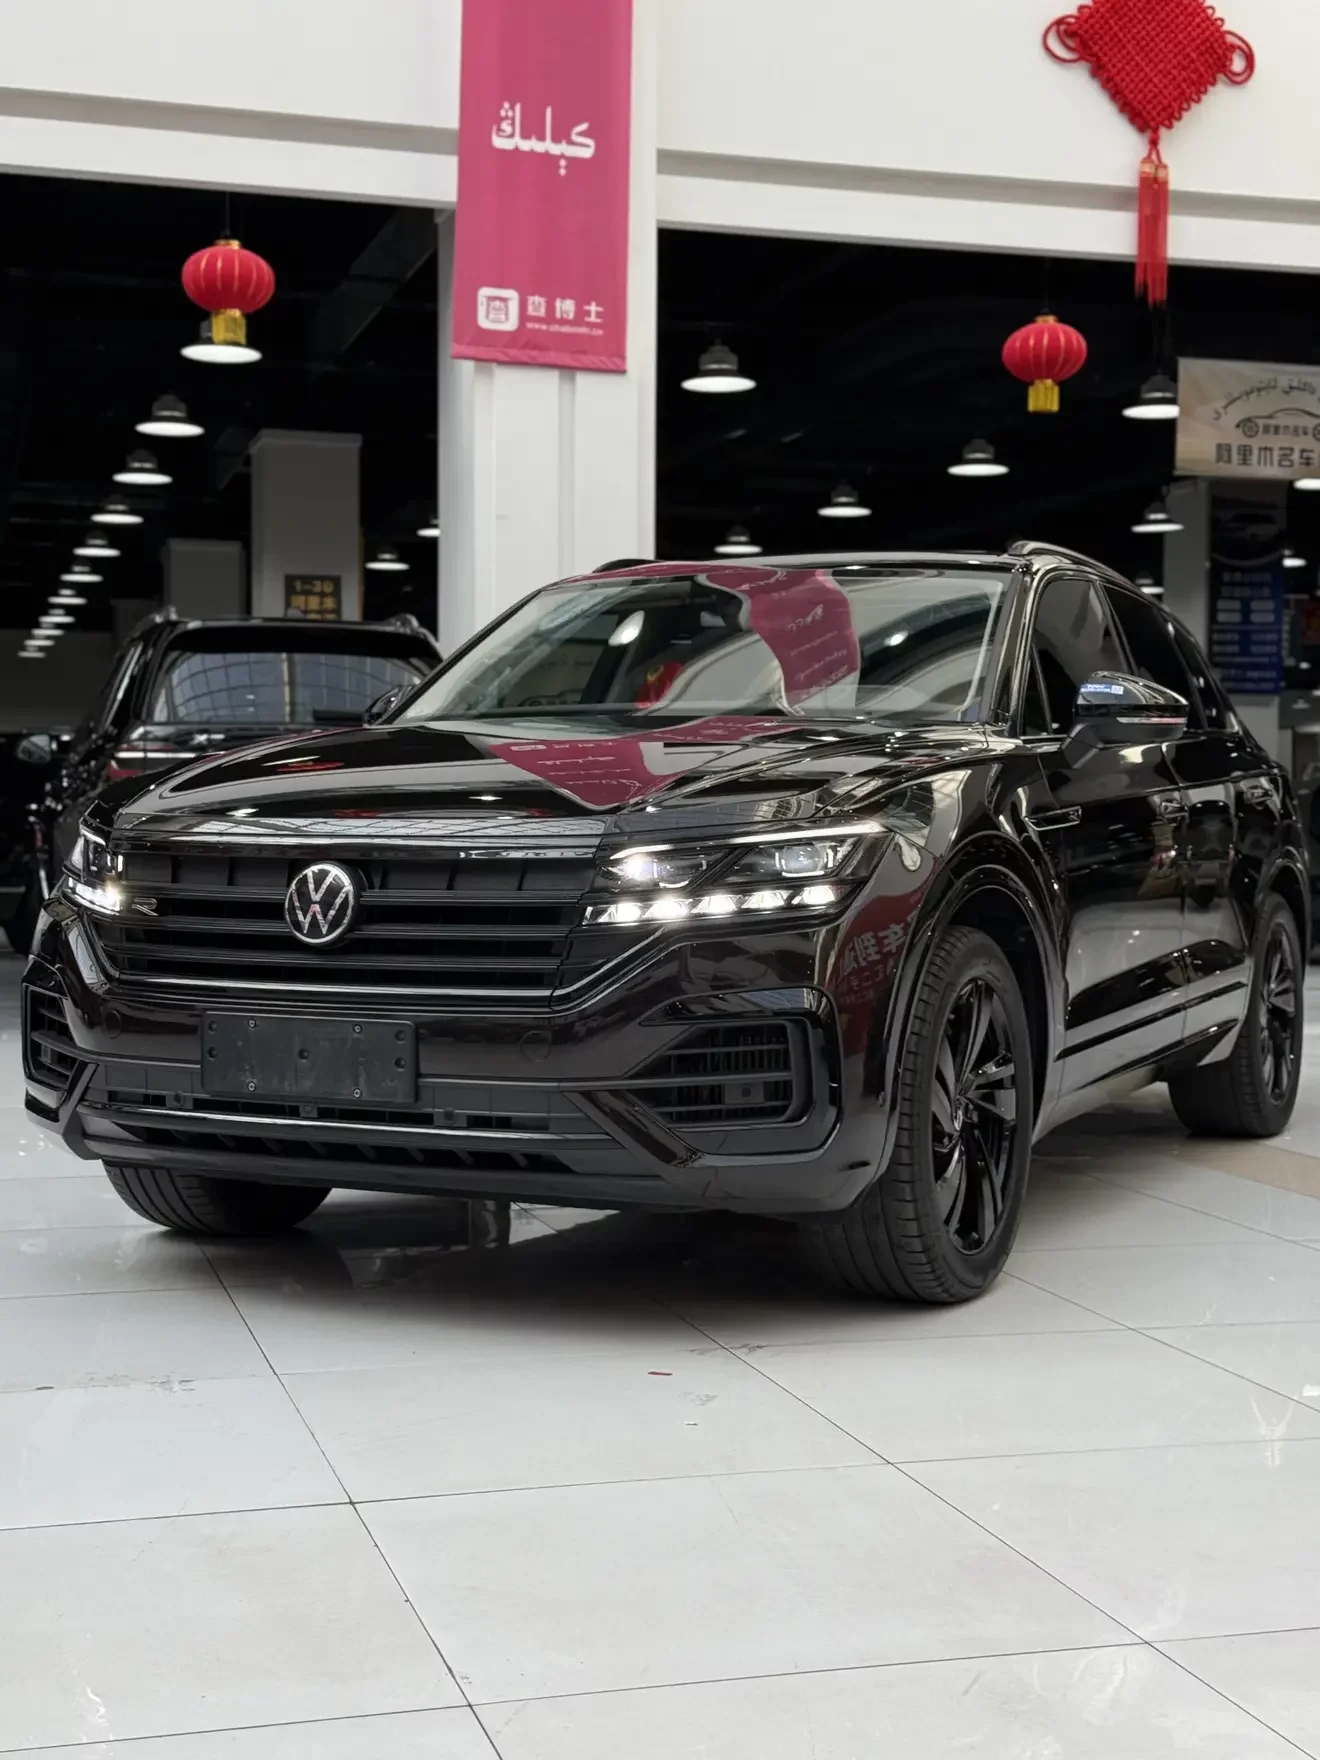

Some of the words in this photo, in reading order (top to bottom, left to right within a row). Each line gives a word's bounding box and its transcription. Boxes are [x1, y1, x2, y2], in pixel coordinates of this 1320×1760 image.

[526, 294, 605, 323] 查博士
[1215, 443, 1316, 468] 阿里木名车
